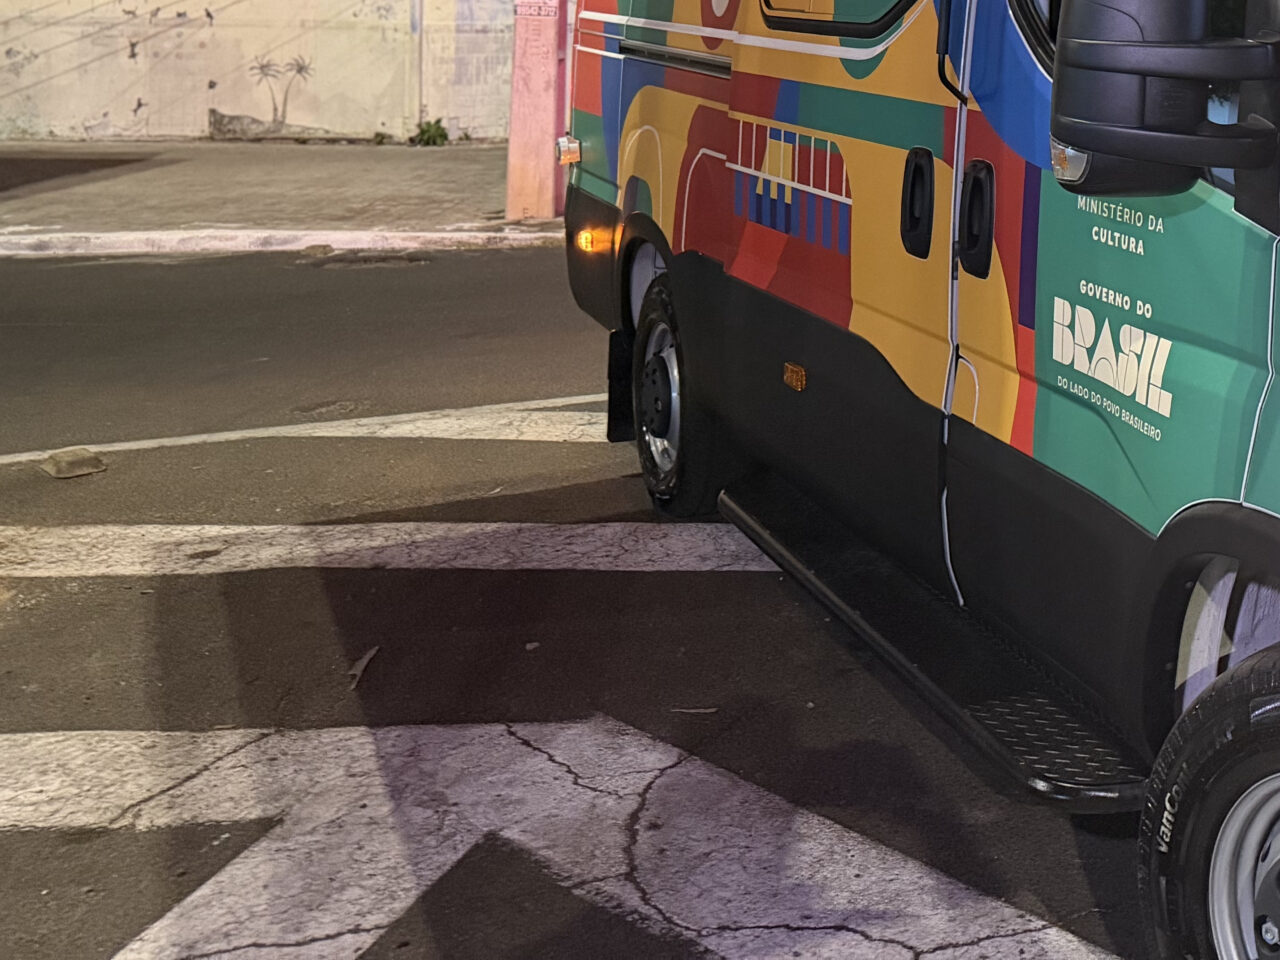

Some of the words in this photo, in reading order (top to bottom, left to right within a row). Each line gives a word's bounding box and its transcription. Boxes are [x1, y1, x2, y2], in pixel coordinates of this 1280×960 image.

[1077, 195, 1142, 227] MINISTÉRIO
[1148, 215, 1164, 233] DA
[1092, 226, 1144, 255] CULTURA
[1080, 279, 1131, 311] GOVERNO
[1136, 300, 1152, 319] DO
[1052, 296, 1173, 418] BRASIL
[1057, 375, 1068, 390] DO
[1069, 380, 1089, 401] LADO
[1091, 391, 1102, 406] DO
[1102, 397, 1120, 418] POVO
[1121, 406, 1162, 441] BRASILEIRO
